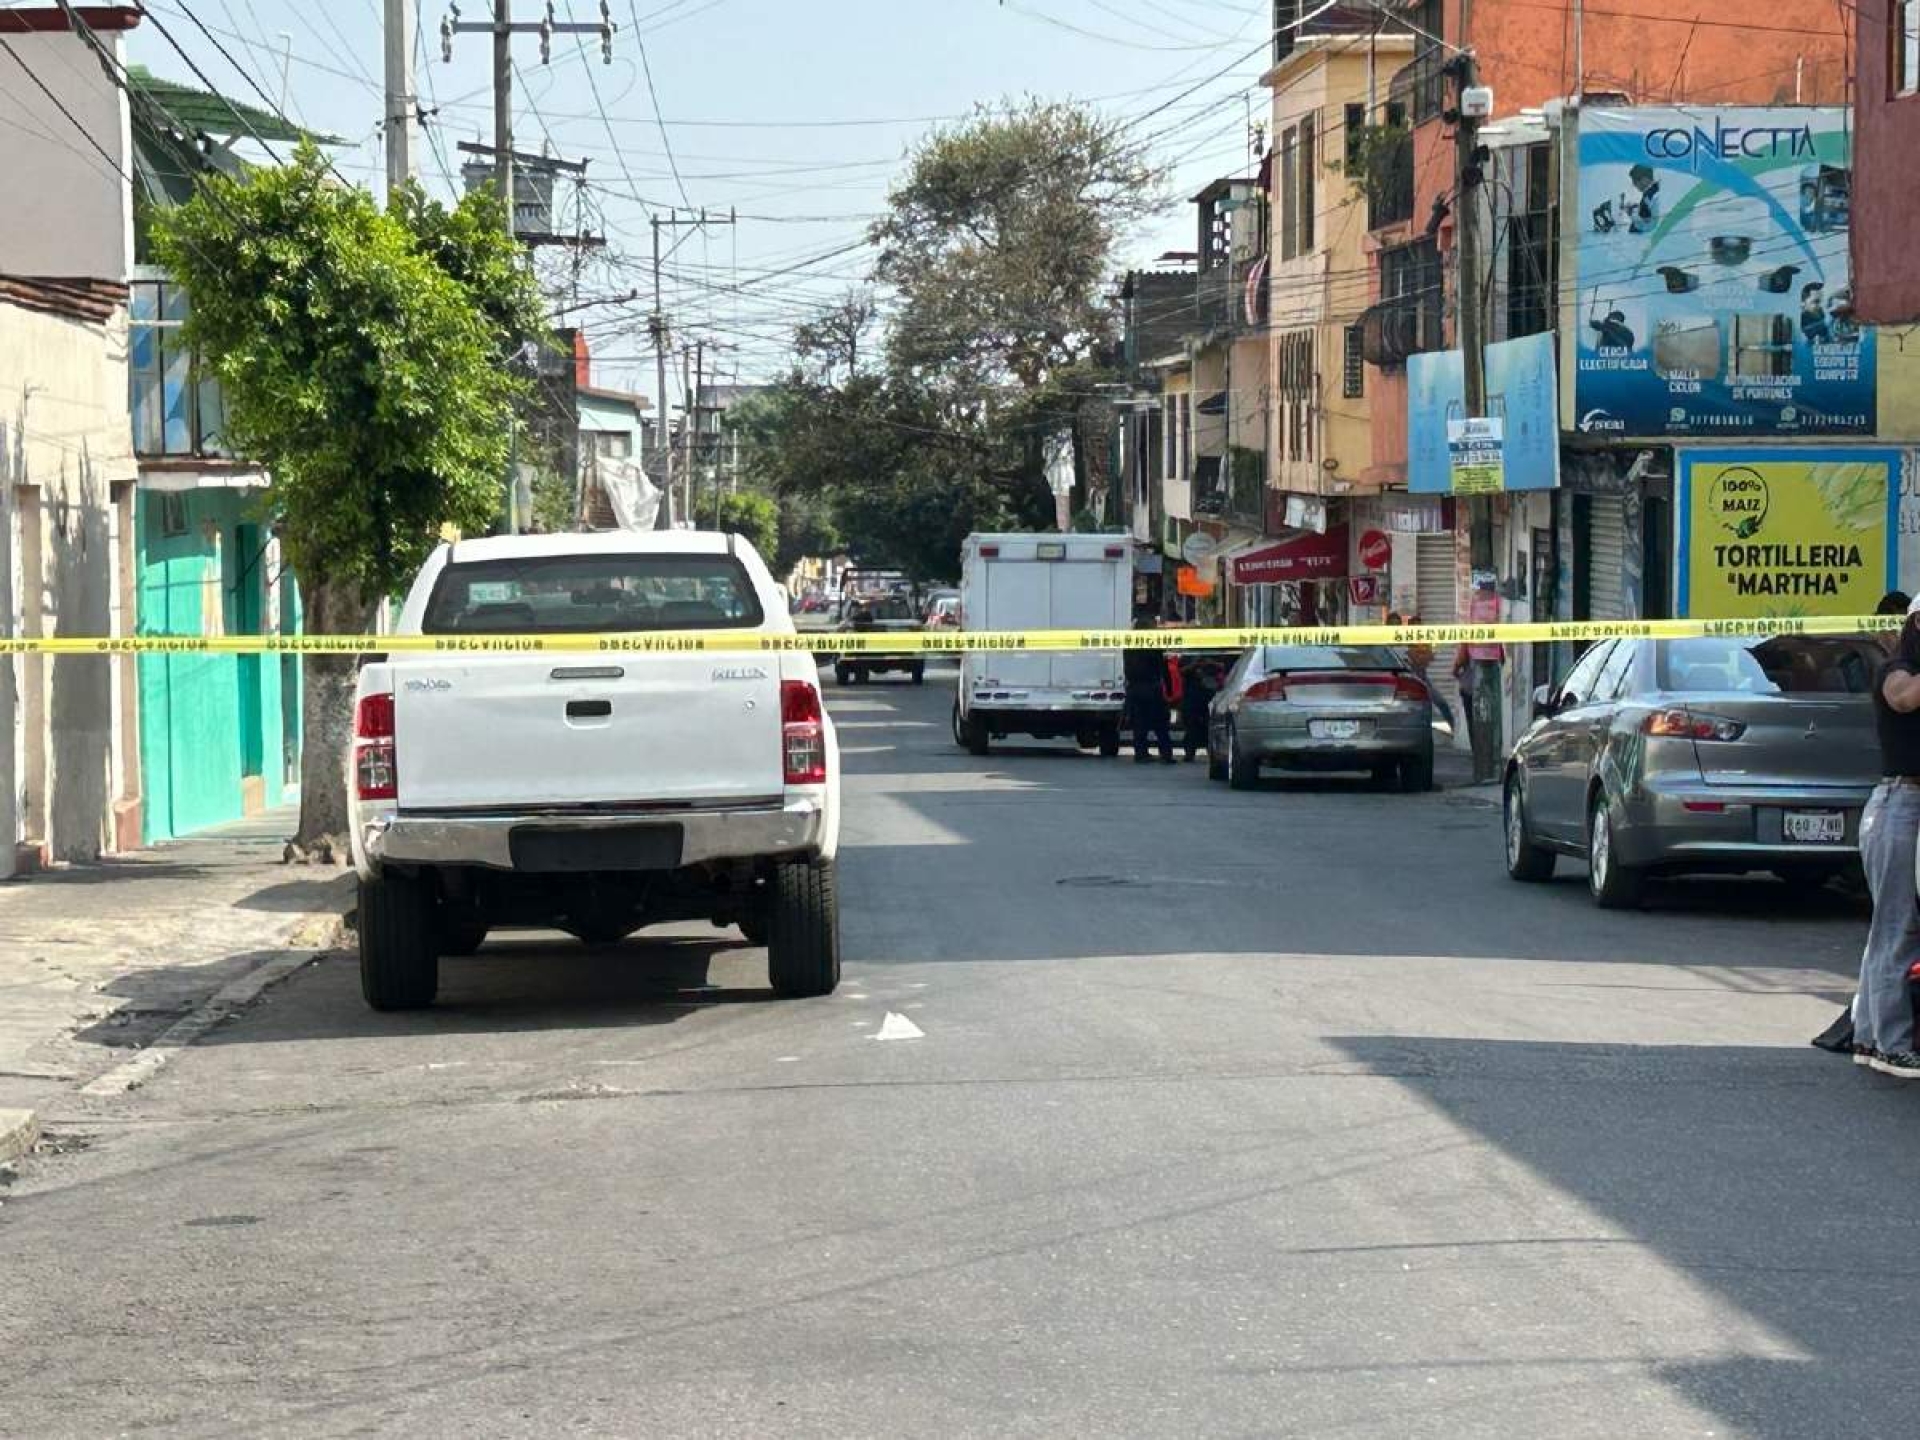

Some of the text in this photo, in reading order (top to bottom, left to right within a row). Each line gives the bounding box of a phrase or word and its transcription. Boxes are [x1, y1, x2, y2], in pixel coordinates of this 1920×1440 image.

[1645, 115, 1816, 173] CONECTTA
[1723, 479, 1762, 492] 100%
[1722, 498, 1761, 512] MAIZ
[1714, 544, 1863, 568] TORTILLERIA
